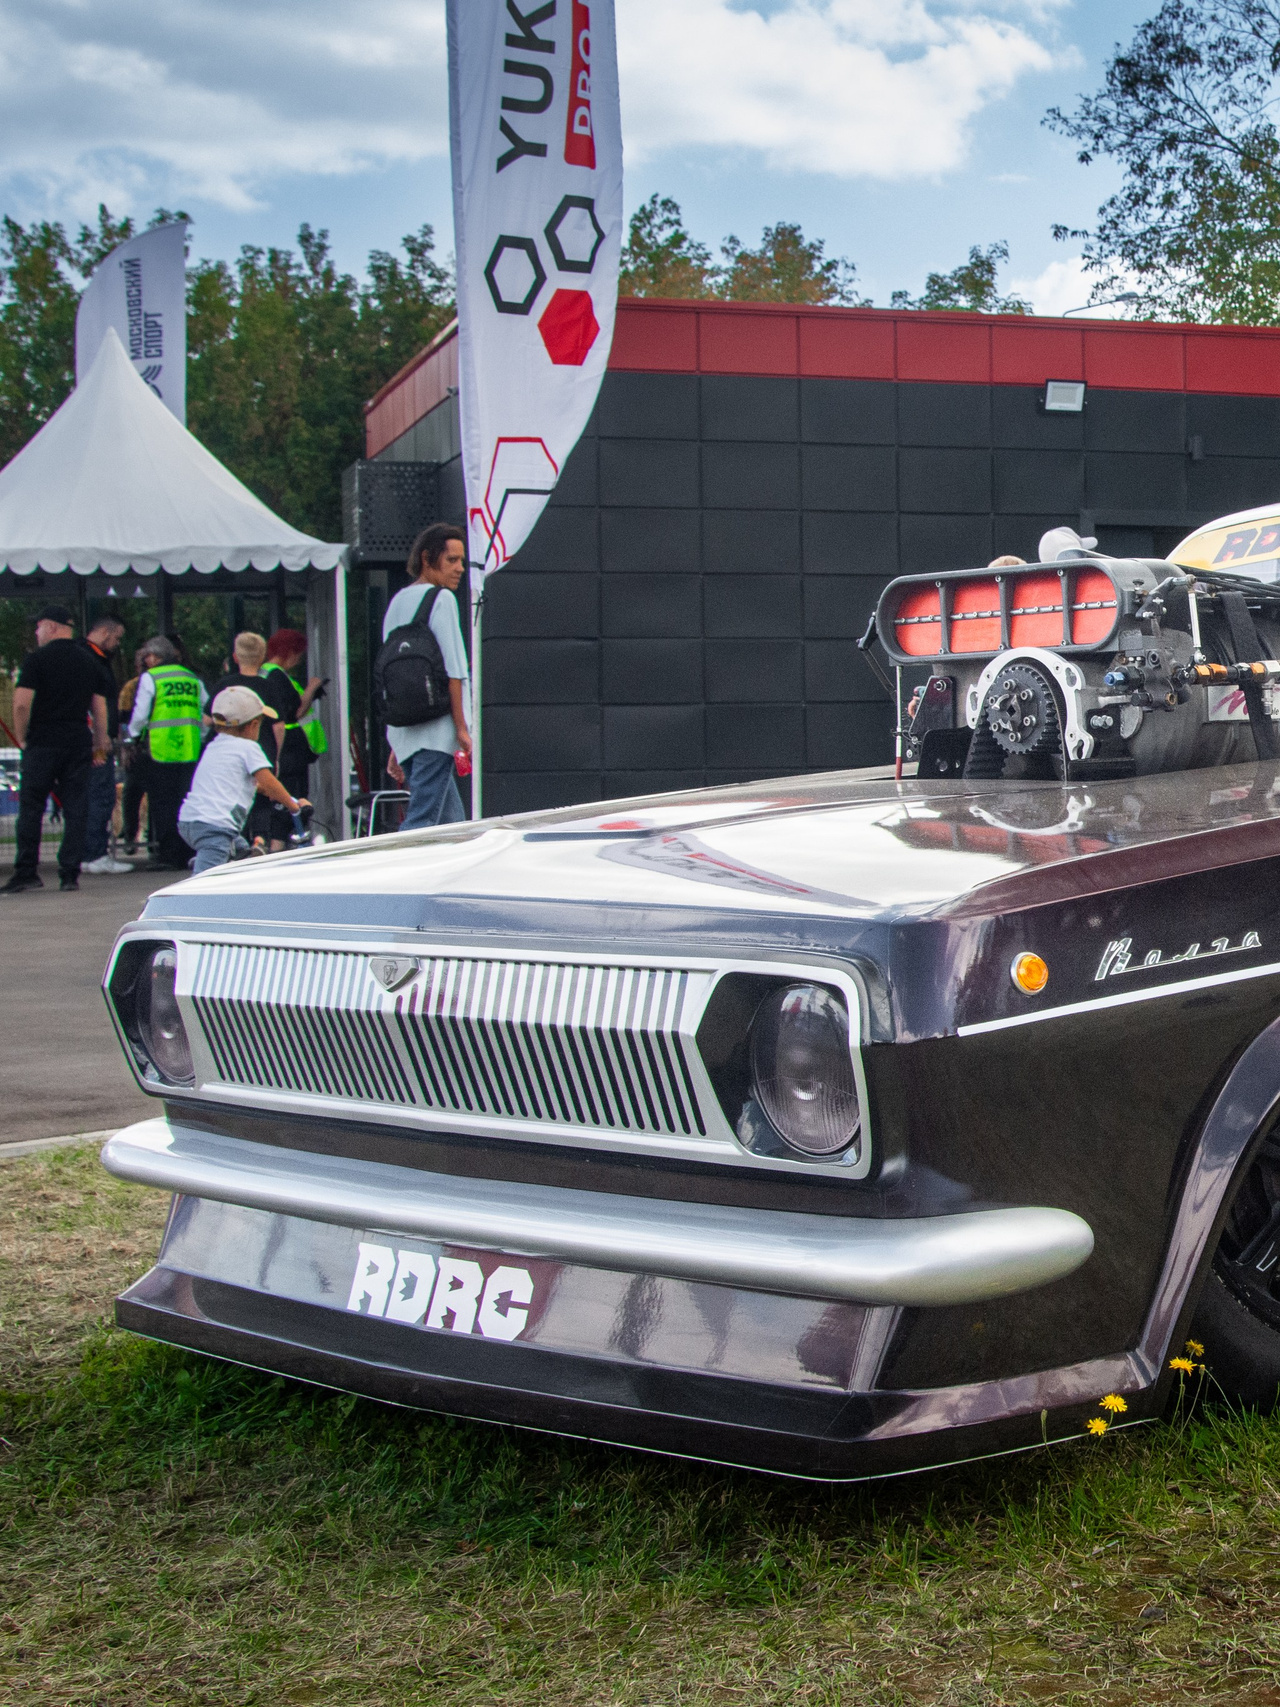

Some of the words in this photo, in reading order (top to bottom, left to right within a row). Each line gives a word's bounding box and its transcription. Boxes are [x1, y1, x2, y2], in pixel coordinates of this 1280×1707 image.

[119, 257, 142, 361] МОСКОВСКИЙ
[144, 312, 163, 359] СПОРТ
[163, 681, 199, 697] 2921
[346, 1241, 535, 1342] RDRC
